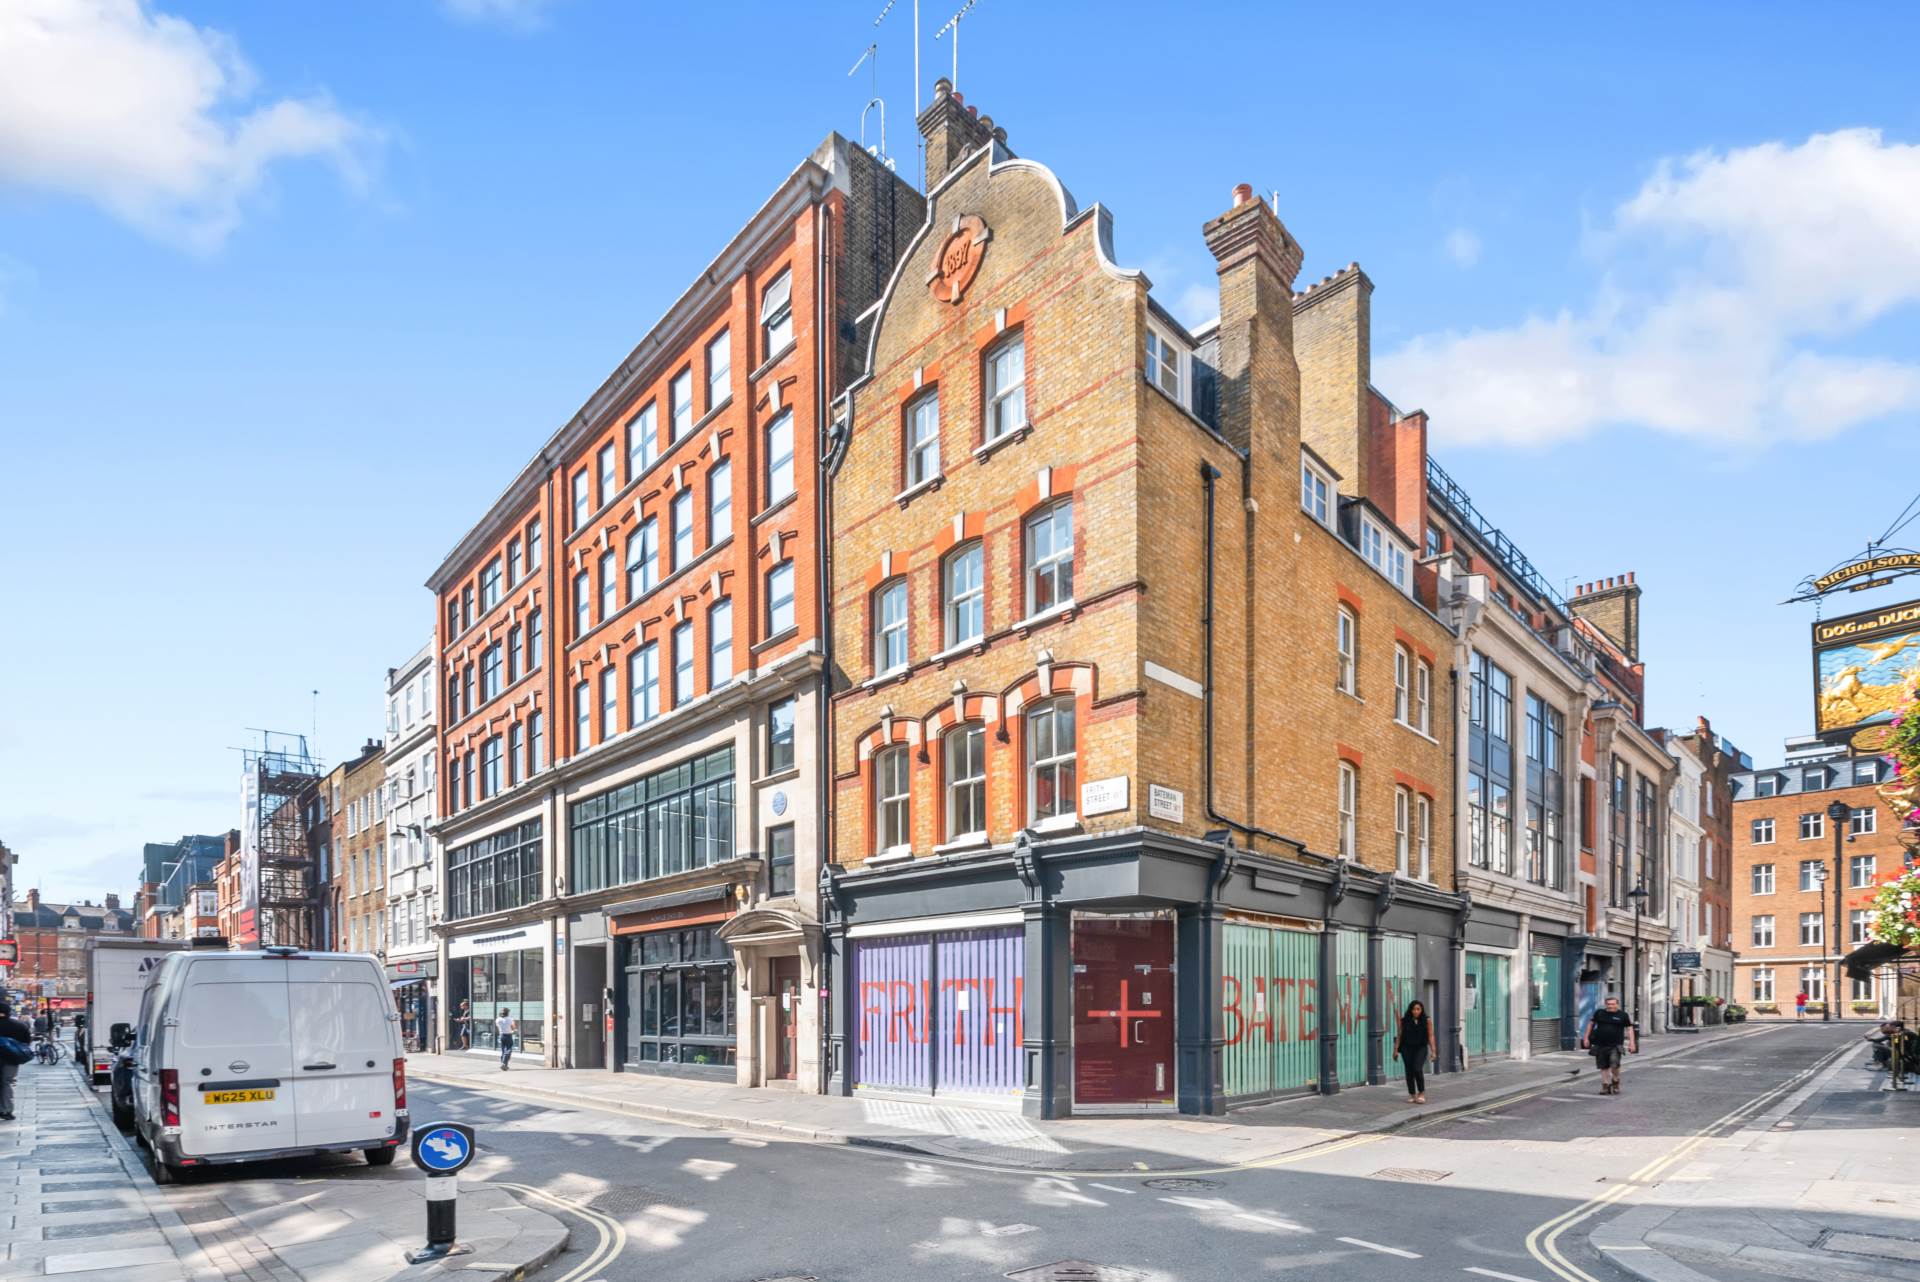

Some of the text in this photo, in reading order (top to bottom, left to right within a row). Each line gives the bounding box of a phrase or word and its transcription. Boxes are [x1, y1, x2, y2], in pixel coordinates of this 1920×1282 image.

[1822, 622, 1856, 639] DOG
[1857, 621, 1878, 631] AND
[1086, 792, 1111, 805] STREET
[1154, 788, 1177, 801] BATEMAN
[1154, 798, 1172, 810] STREET
[860, 976, 1024, 1048] FRITH
[213, 1090, 274, 1103] WG25 XLU
[204, 1121, 278, 1132] INTERSTAR
